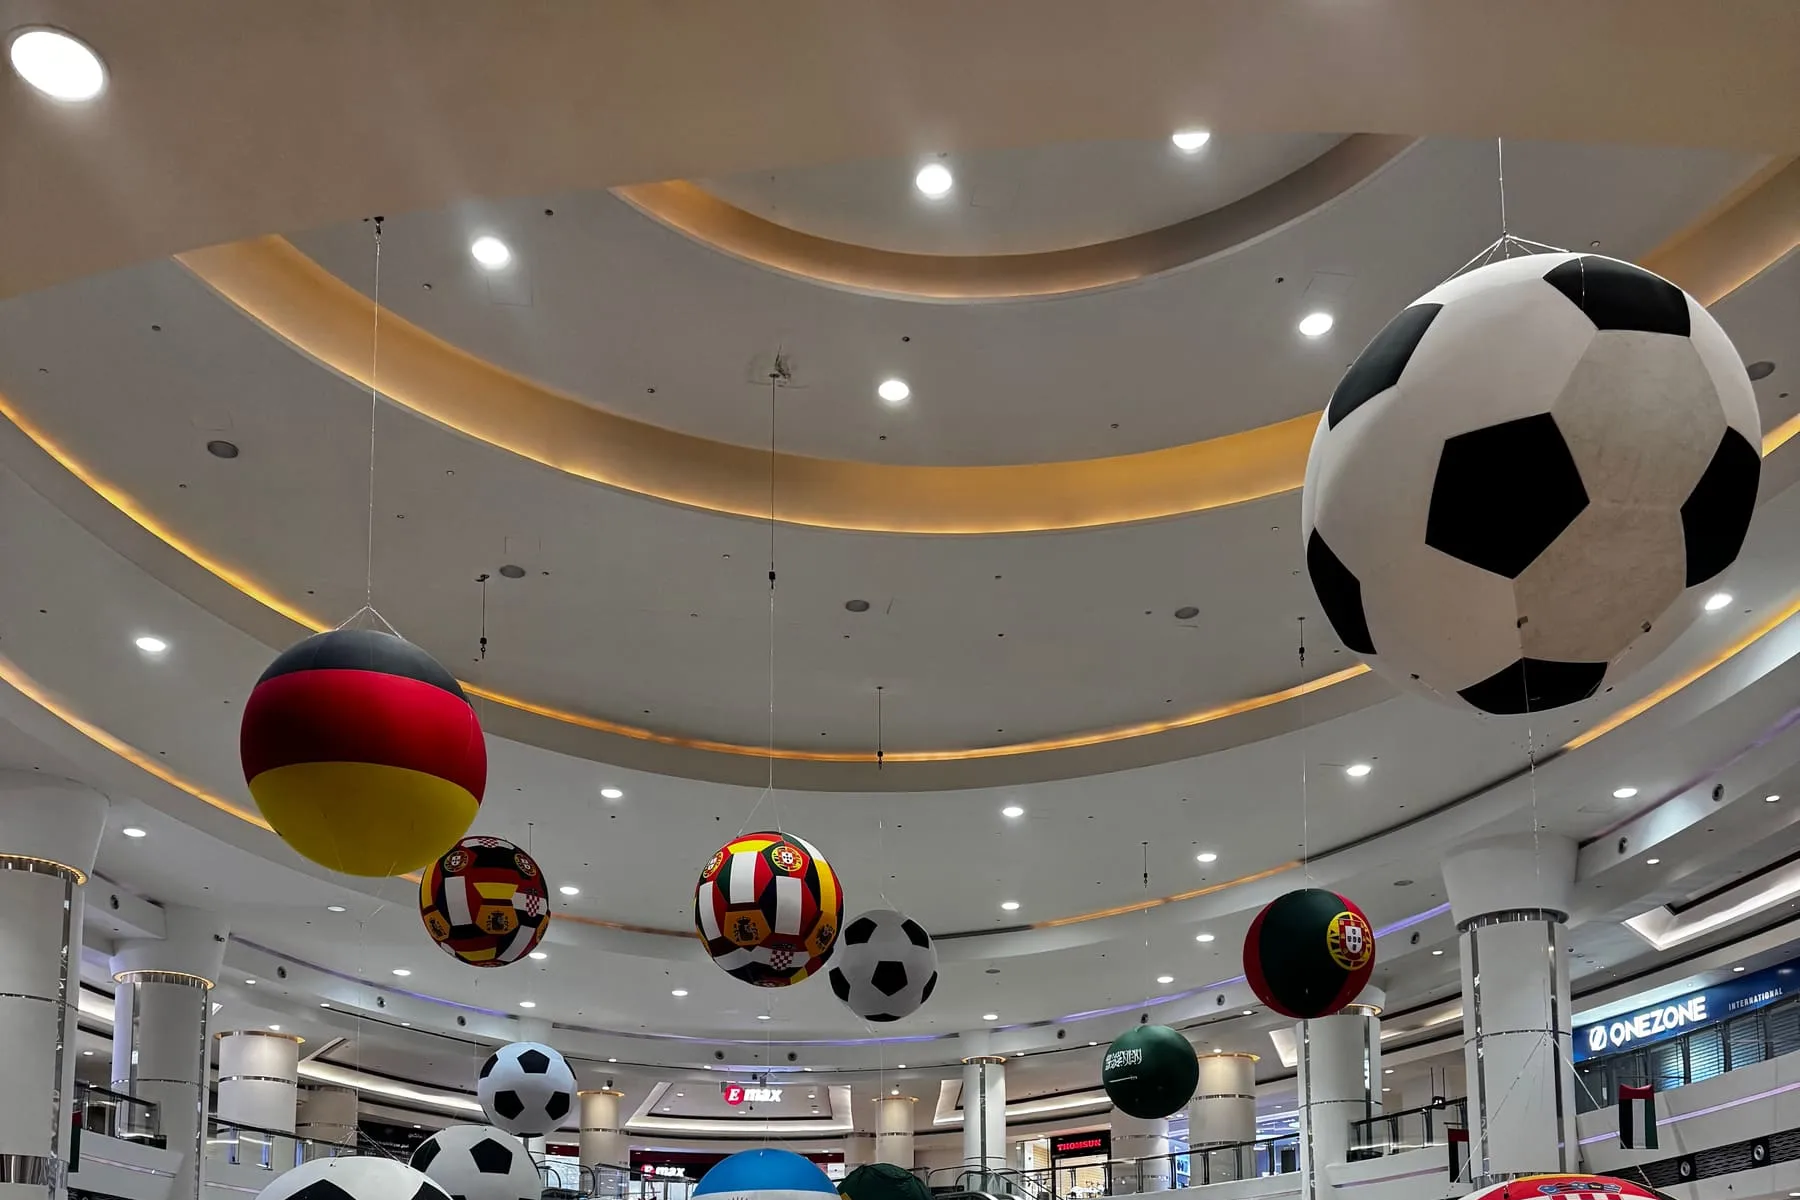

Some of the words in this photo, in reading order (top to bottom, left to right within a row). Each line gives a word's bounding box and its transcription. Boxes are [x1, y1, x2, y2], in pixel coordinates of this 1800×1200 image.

[1609, 995, 1707, 1047] ONEZONE
[1728, 987, 1783, 1011] INTERNATIONAL
[1056, 1139, 1102, 1151] THOMSUN
